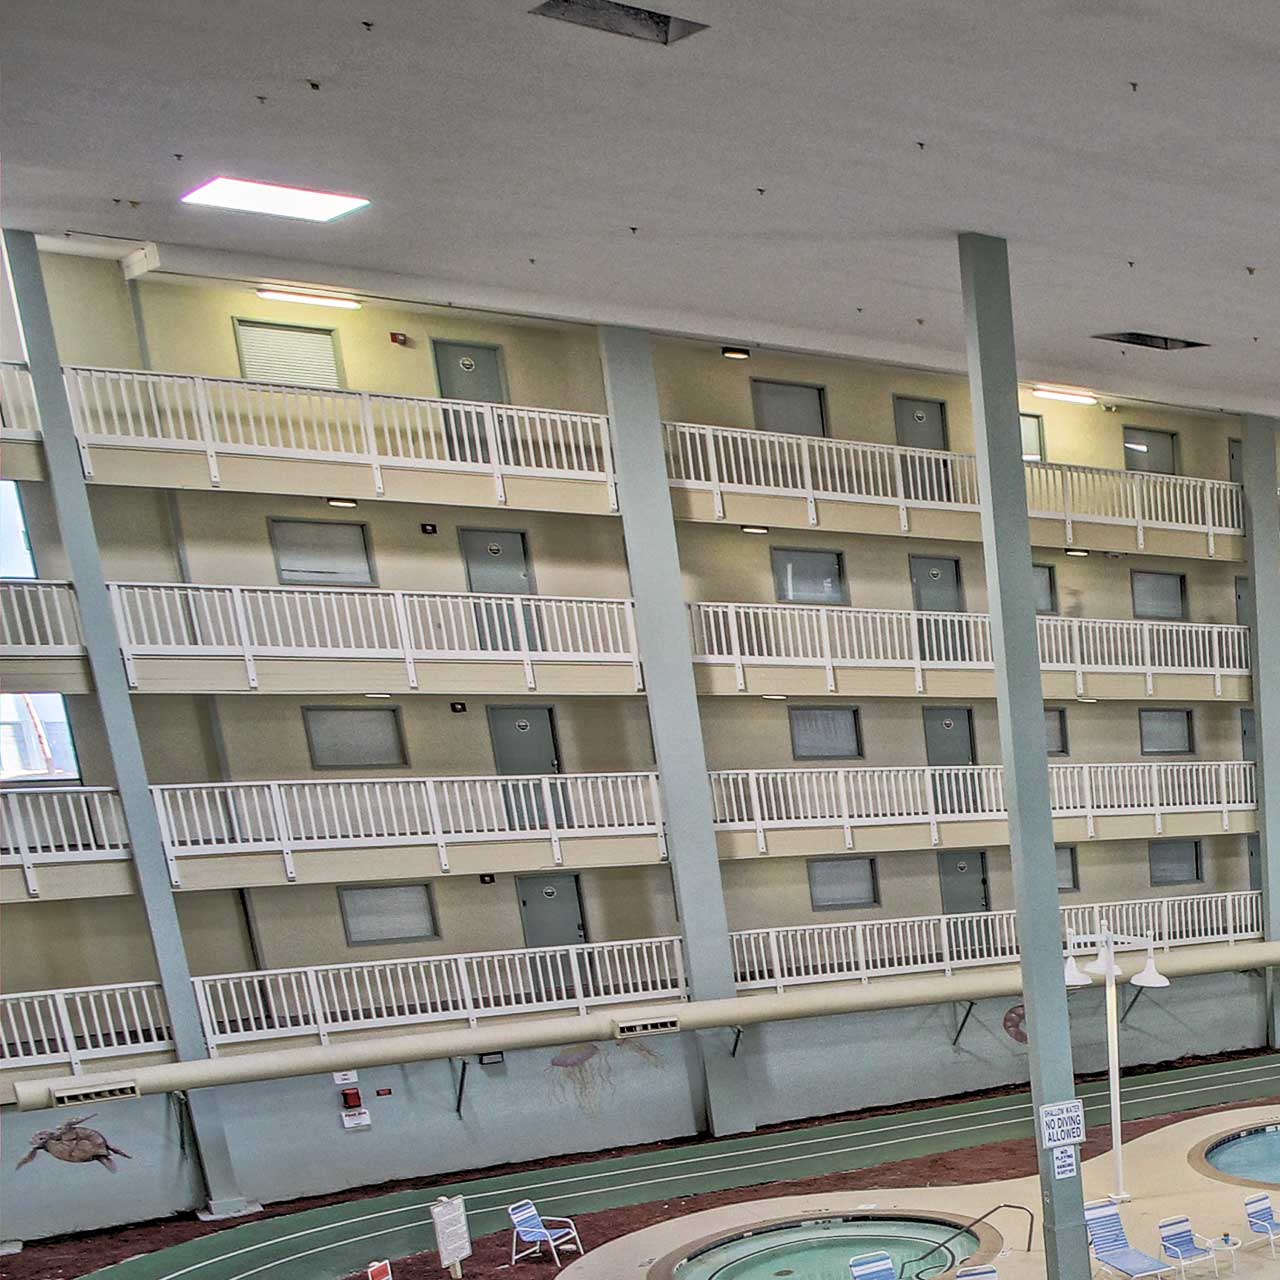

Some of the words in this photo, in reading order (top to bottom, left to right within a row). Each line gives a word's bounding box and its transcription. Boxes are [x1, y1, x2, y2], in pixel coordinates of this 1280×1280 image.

[1045, 1118, 1056, 1130] NO
[1057, 1114, 1081, 1129] DIVING
[1047, 1127, 1082, 1143] ALLOWED
